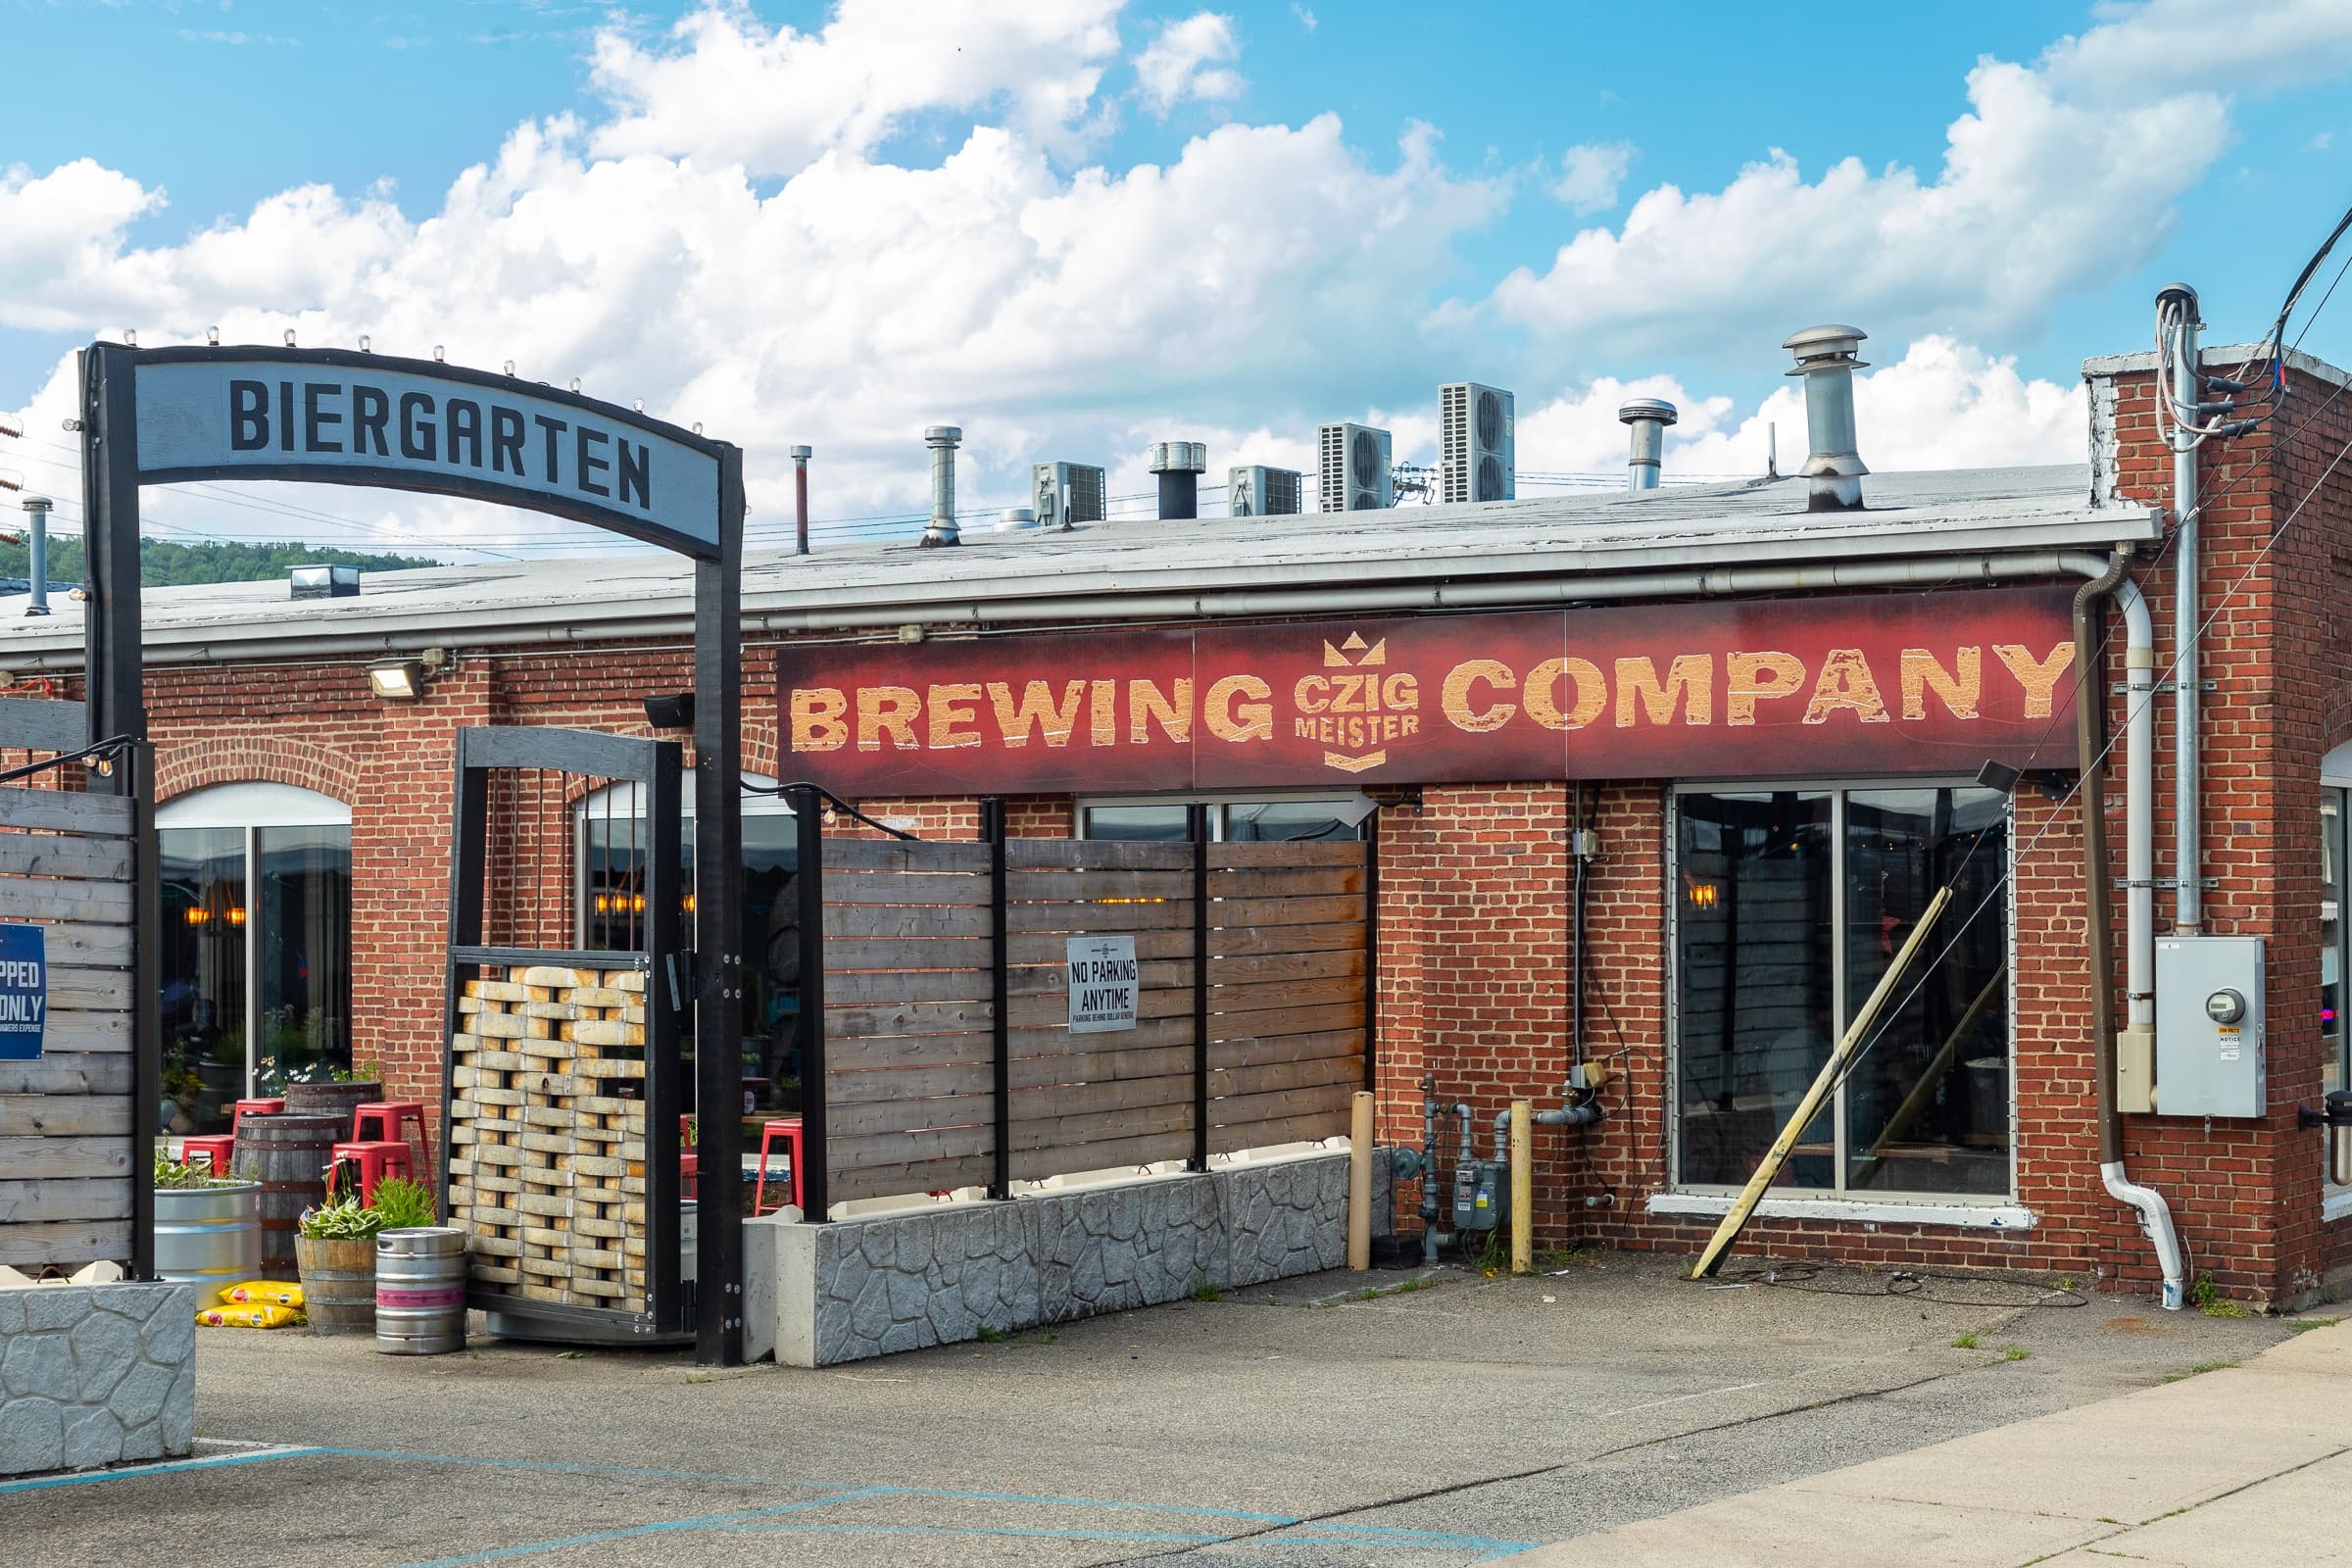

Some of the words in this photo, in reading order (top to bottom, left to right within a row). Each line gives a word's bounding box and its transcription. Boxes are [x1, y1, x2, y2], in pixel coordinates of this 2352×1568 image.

[230, 379, 651, 511] BIERGARTEN
[789, 673, 1274, 753] BREWING
[1441, 641, 2076, 734] COMPANY
[1294, 672, 1419, 714] CZIG
[1294, 714, 1420, 749] MEISTER
[1071, 961, 1088, 984] NO
[1092, 959, 1136, 983] PARKING
[0, 994, 43, 1021] ONLY
[1081, 987, 1130, 1012] ANYTIME
[20, 1024, 41, 1033] EXPENSE
[1073, 1014, 1091, 1023] PARKING
[1106, 1012, 1120, 1021] DOLLAR
